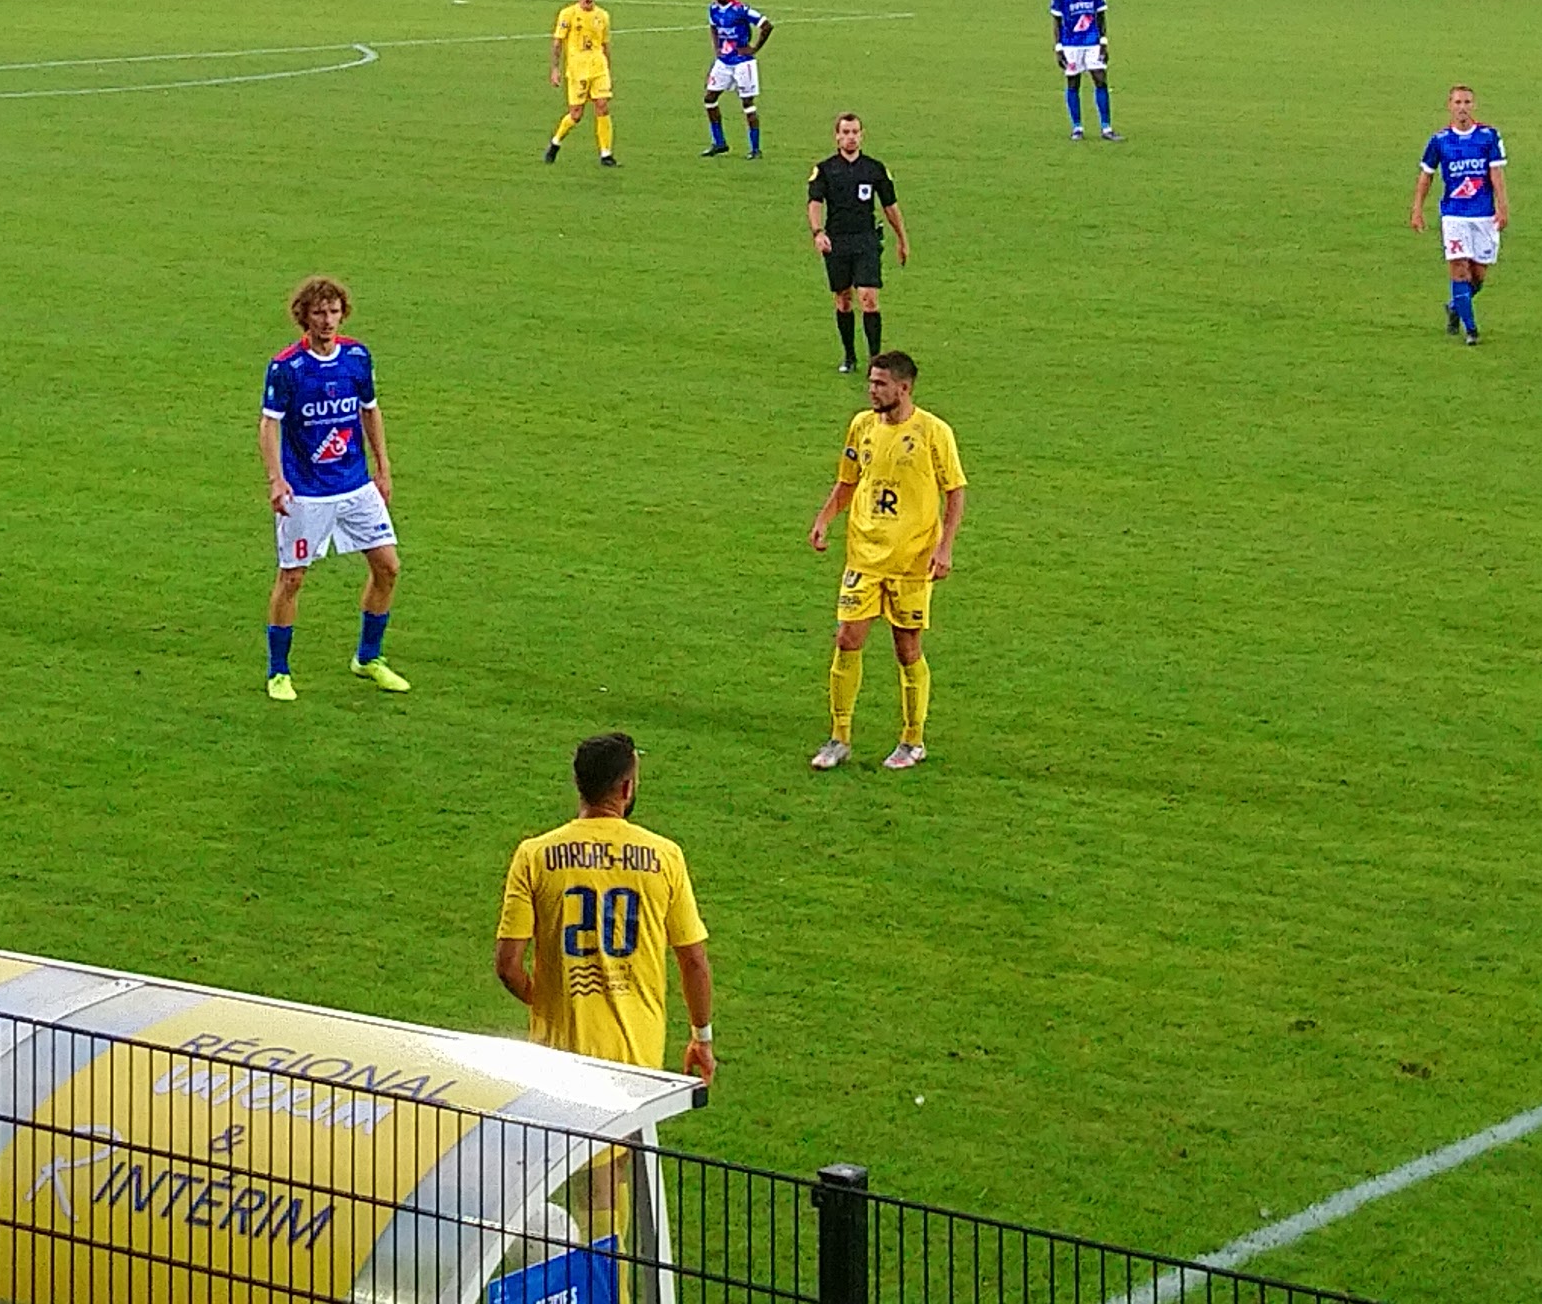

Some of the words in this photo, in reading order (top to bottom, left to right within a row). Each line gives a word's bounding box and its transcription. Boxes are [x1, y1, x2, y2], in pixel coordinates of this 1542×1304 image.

[301, 396, 359, 418] GUYOT
[294, 538, 309, 561] 8
[562, 885, 640, 959] 20
[181, 1032, 458, 1106] RÉGIONAL
